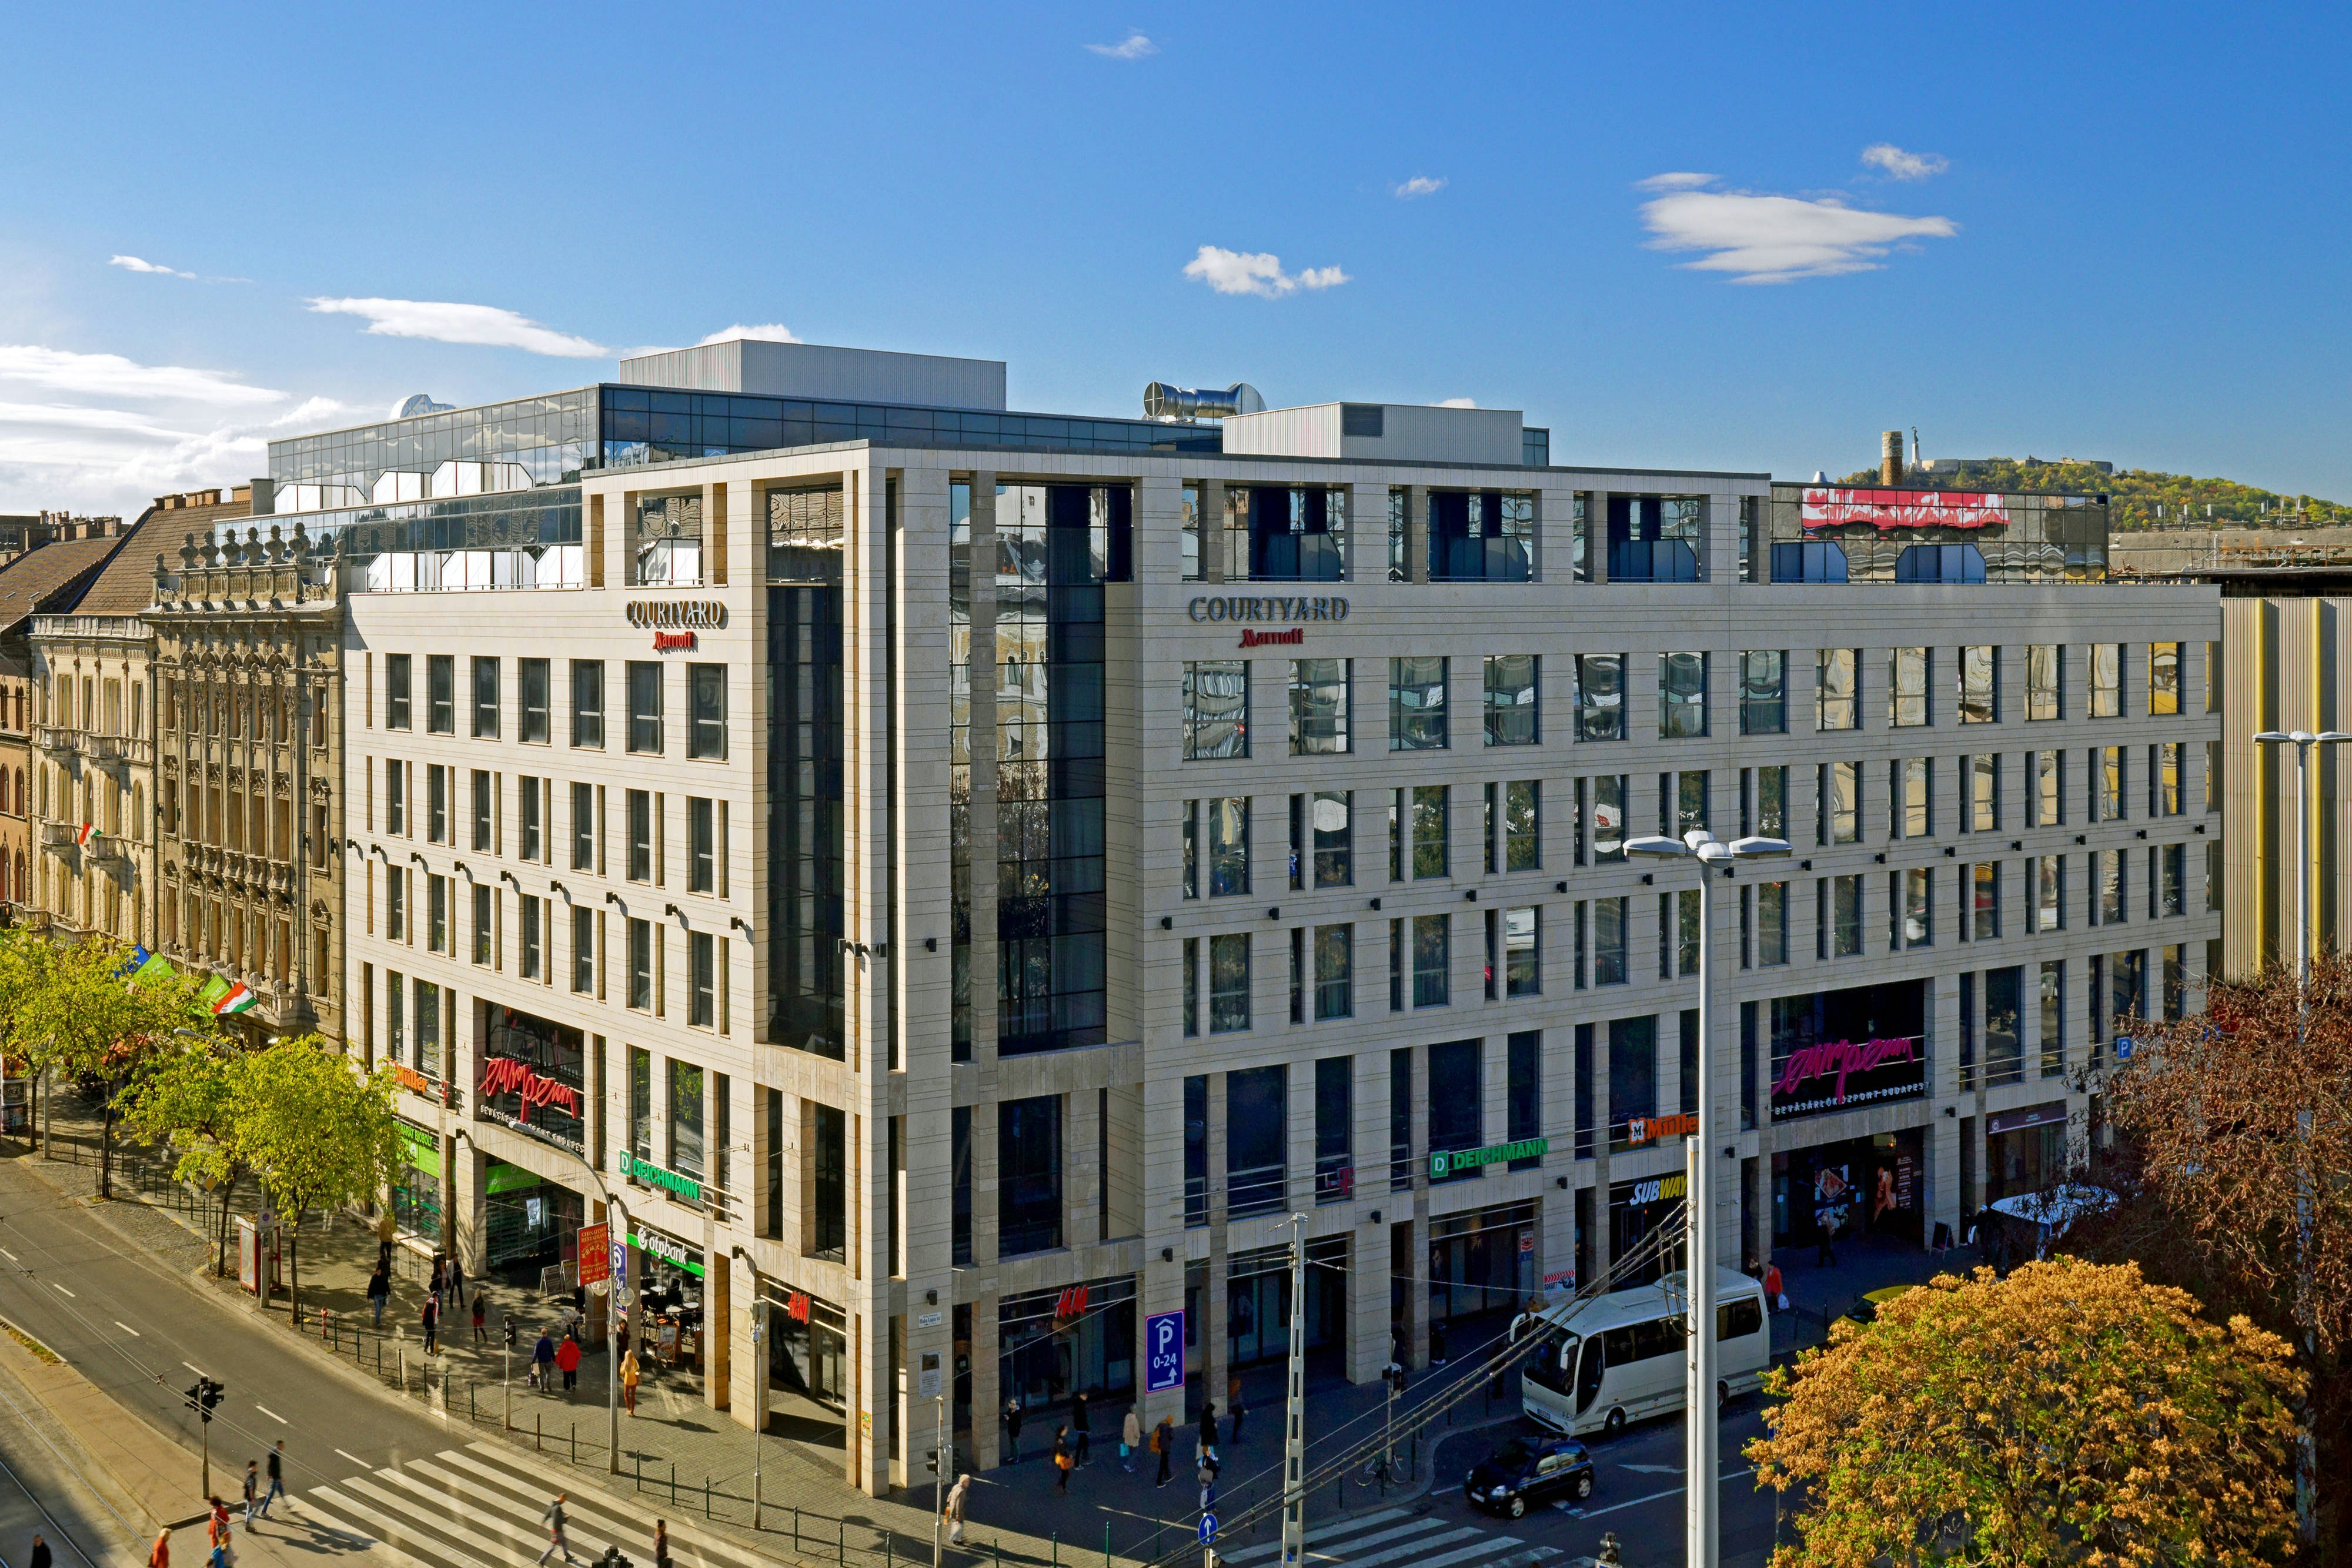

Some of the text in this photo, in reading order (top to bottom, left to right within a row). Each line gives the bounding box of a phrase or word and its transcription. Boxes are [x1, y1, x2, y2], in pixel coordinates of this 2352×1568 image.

[624, 600, 724, 626] COURTYARD
[1189, 596, 1351, 622] COURTYARD
[653, 631, 695, 650] Marriott
[1238, 628, 1304, 648] Marriott
[1882, 1081, 1930, 1096] BUDAPEST
[1646, 1112, 1699, 1140] Mülle
[1452, 1138, 1549, 1170] DEICHMANN
[633, 1159, 700, 1200] DEICHMANN
[1629, 1175, 1688, 1206] SUBWAY
[649, 1235, 689, 1265] otpbank
[787, 1290, 811, 1325] H&M
[1054, 1285, 1088, 1318] H&M
[1159, 1326, 1173, 1354] P
[1153, 1353, 1177, 1369] 0-24
